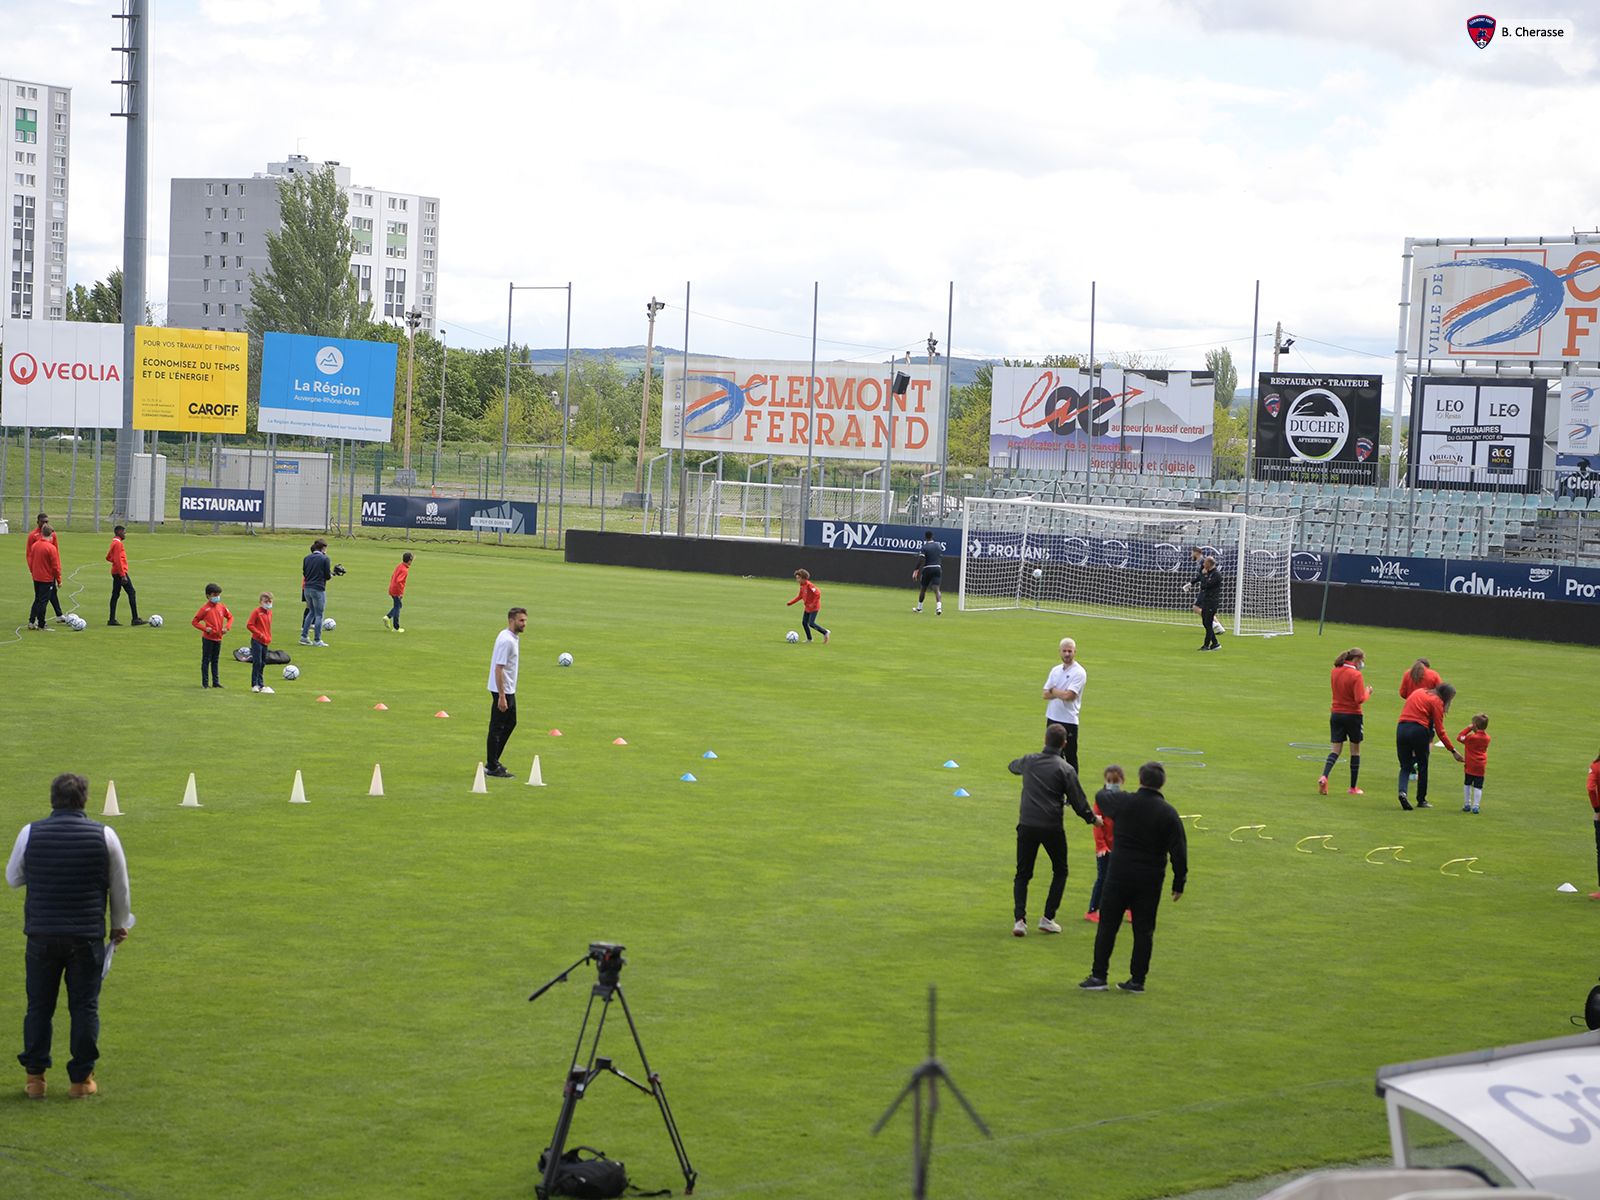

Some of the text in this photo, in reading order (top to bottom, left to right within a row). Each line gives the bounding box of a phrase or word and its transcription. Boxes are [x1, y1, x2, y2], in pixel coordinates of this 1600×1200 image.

[1429, 274, 1444, 354] VILLE DE
[177, 342, 203, 350] TRAVAUX
[143, 356, 240, 372] ÉCONOMISEZ DU TEMPS
[42, 362, 120, 382] VEOLIA
[142, 370, 152, 378] ET
[155, 371, 166, 379] DE
[169, 371, 209, 382] L'ÉNERGIE
[294, 379, 361, 397] La Région
[1270, 377, 1323, 387] RESTAURANT
[1327, 379, 1370, 388] TRAITEUR
[294, 395, 361, 407] Auvergne-Rhône-Alpes
[745, 374, 932, 413] CLERMONT
[188, 402, 239, 417] CAROFF
[1436, 399, 1464, 412] LEO
[673, 404, 682, 437] VILLE
[1290, 419, 1345, 434] DUCHER
[745, 410, 932, 450] FERRAND
[1111, 424, 1121, 432] au
[1143, 423, 1153, 433] du
[1155, 424, 1179, 434] Massif
[1179, 424, 1205, 434] central
[1451, 426, 1500, 434] PARTENAIRES
[1491, 448, 1512, 458] ace
[1146, 461, 1158, 471] et
[181, 497, 263, 513] RESTAURANT
[361, 501, 387, 517] ME
[1450, 572, 1494, 596] CdM
[1497, 586, 1545, 600] intérim
